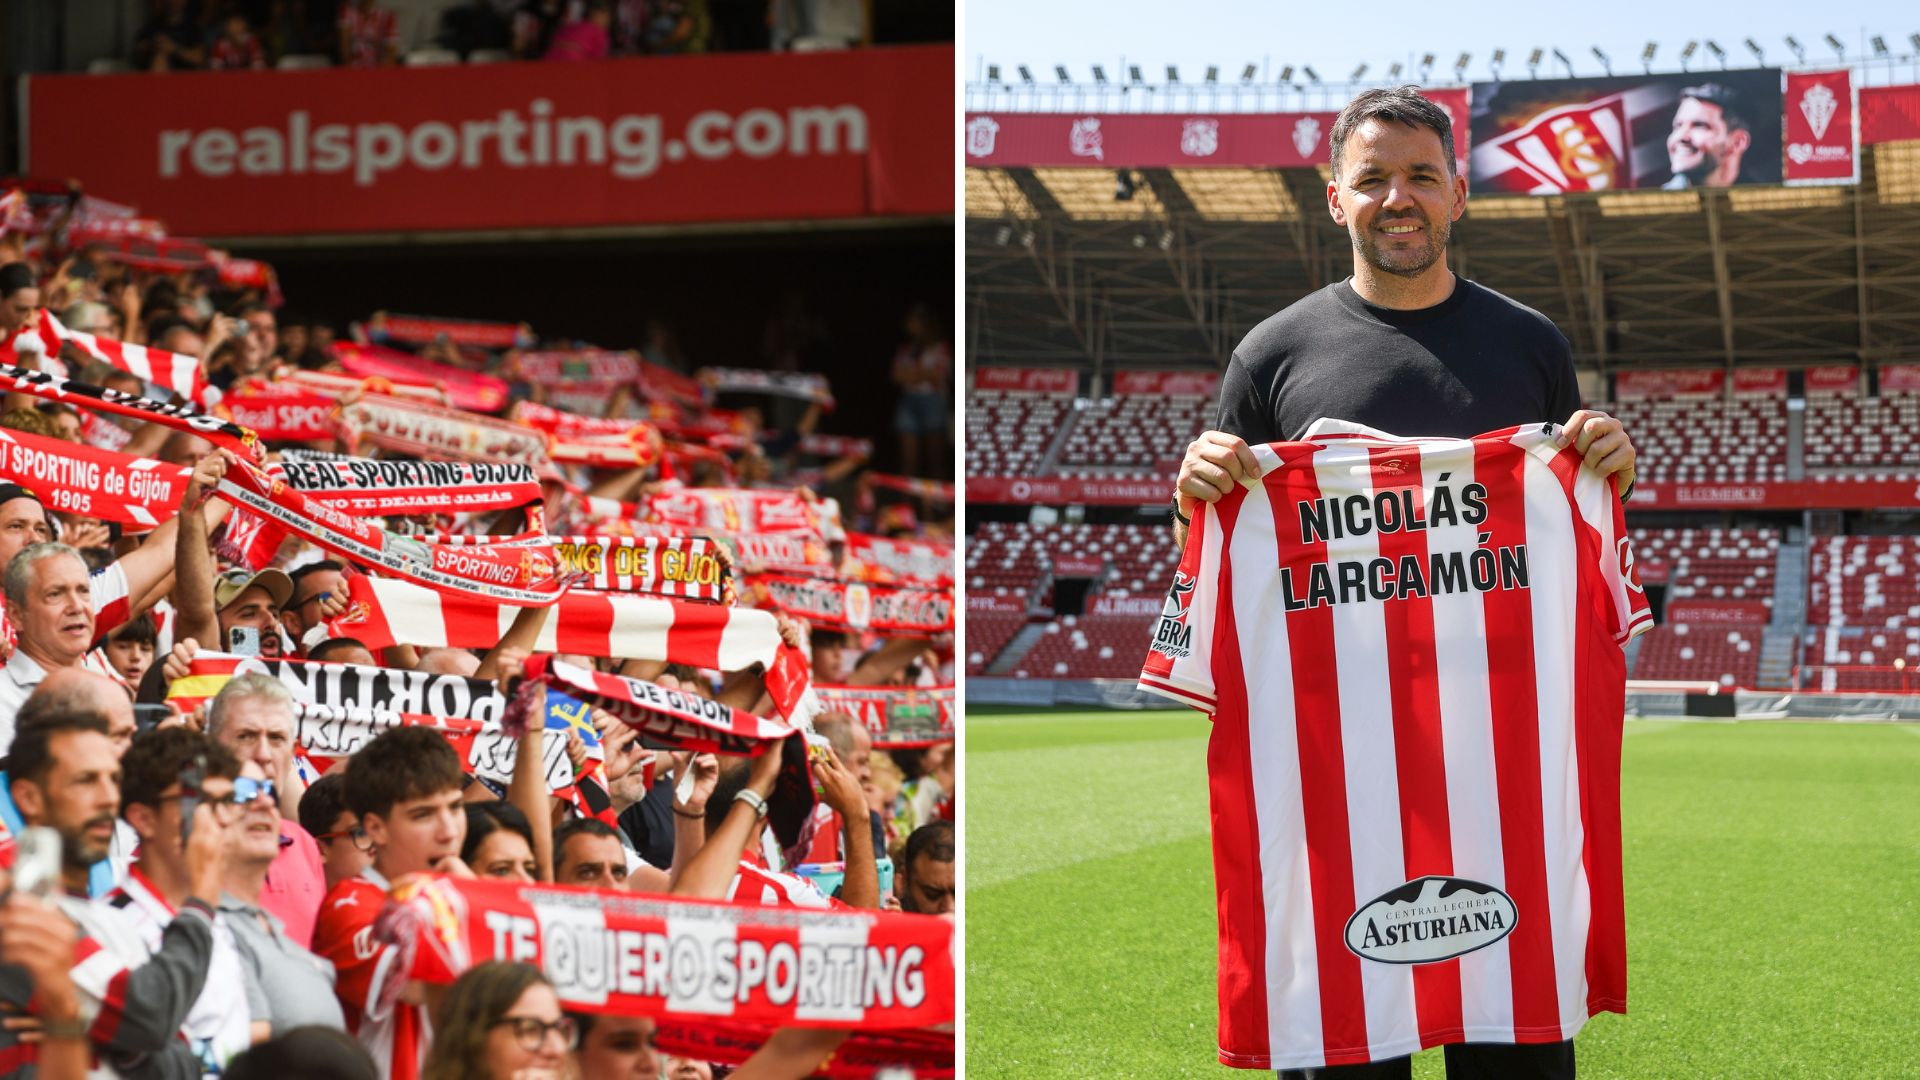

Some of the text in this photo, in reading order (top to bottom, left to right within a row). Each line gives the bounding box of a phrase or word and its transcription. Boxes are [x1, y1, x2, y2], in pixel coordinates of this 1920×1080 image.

[159, 99, 869, 185] realsporting.com
[12, 445, 100, 491] SPORTING
[104, 466, 125, 495] de
[129, 470, 172, 506] Gijón
[282, 462, 347, 489] REAL
[348, 461, 464, 488] SPORTING
[51, 488, 91, 513] 1905
[239, 490, 271, 512] Estadio
[271, 506, 282, 517] El
[320, 490, 513, 510] NO TE DEJARÉ JAMÁS
[1298, 472, 1488, 545] NICOLÁS
[435, 550, 519, 584] SPORTING!
[554, 544, 603, 575] ING
[614, 546, 649, 577] DE
[1279, 532, 1531, 613] LARCAMÓN
[628, 680, 662, 704] DE
[1386, 897, 1497, 921] CENTRAL LECHERA
[485, 909, 537, 962] TE
[545, 922, 699, 1000] QUIERO
[710, 938, 925, 1009] SPORTING
